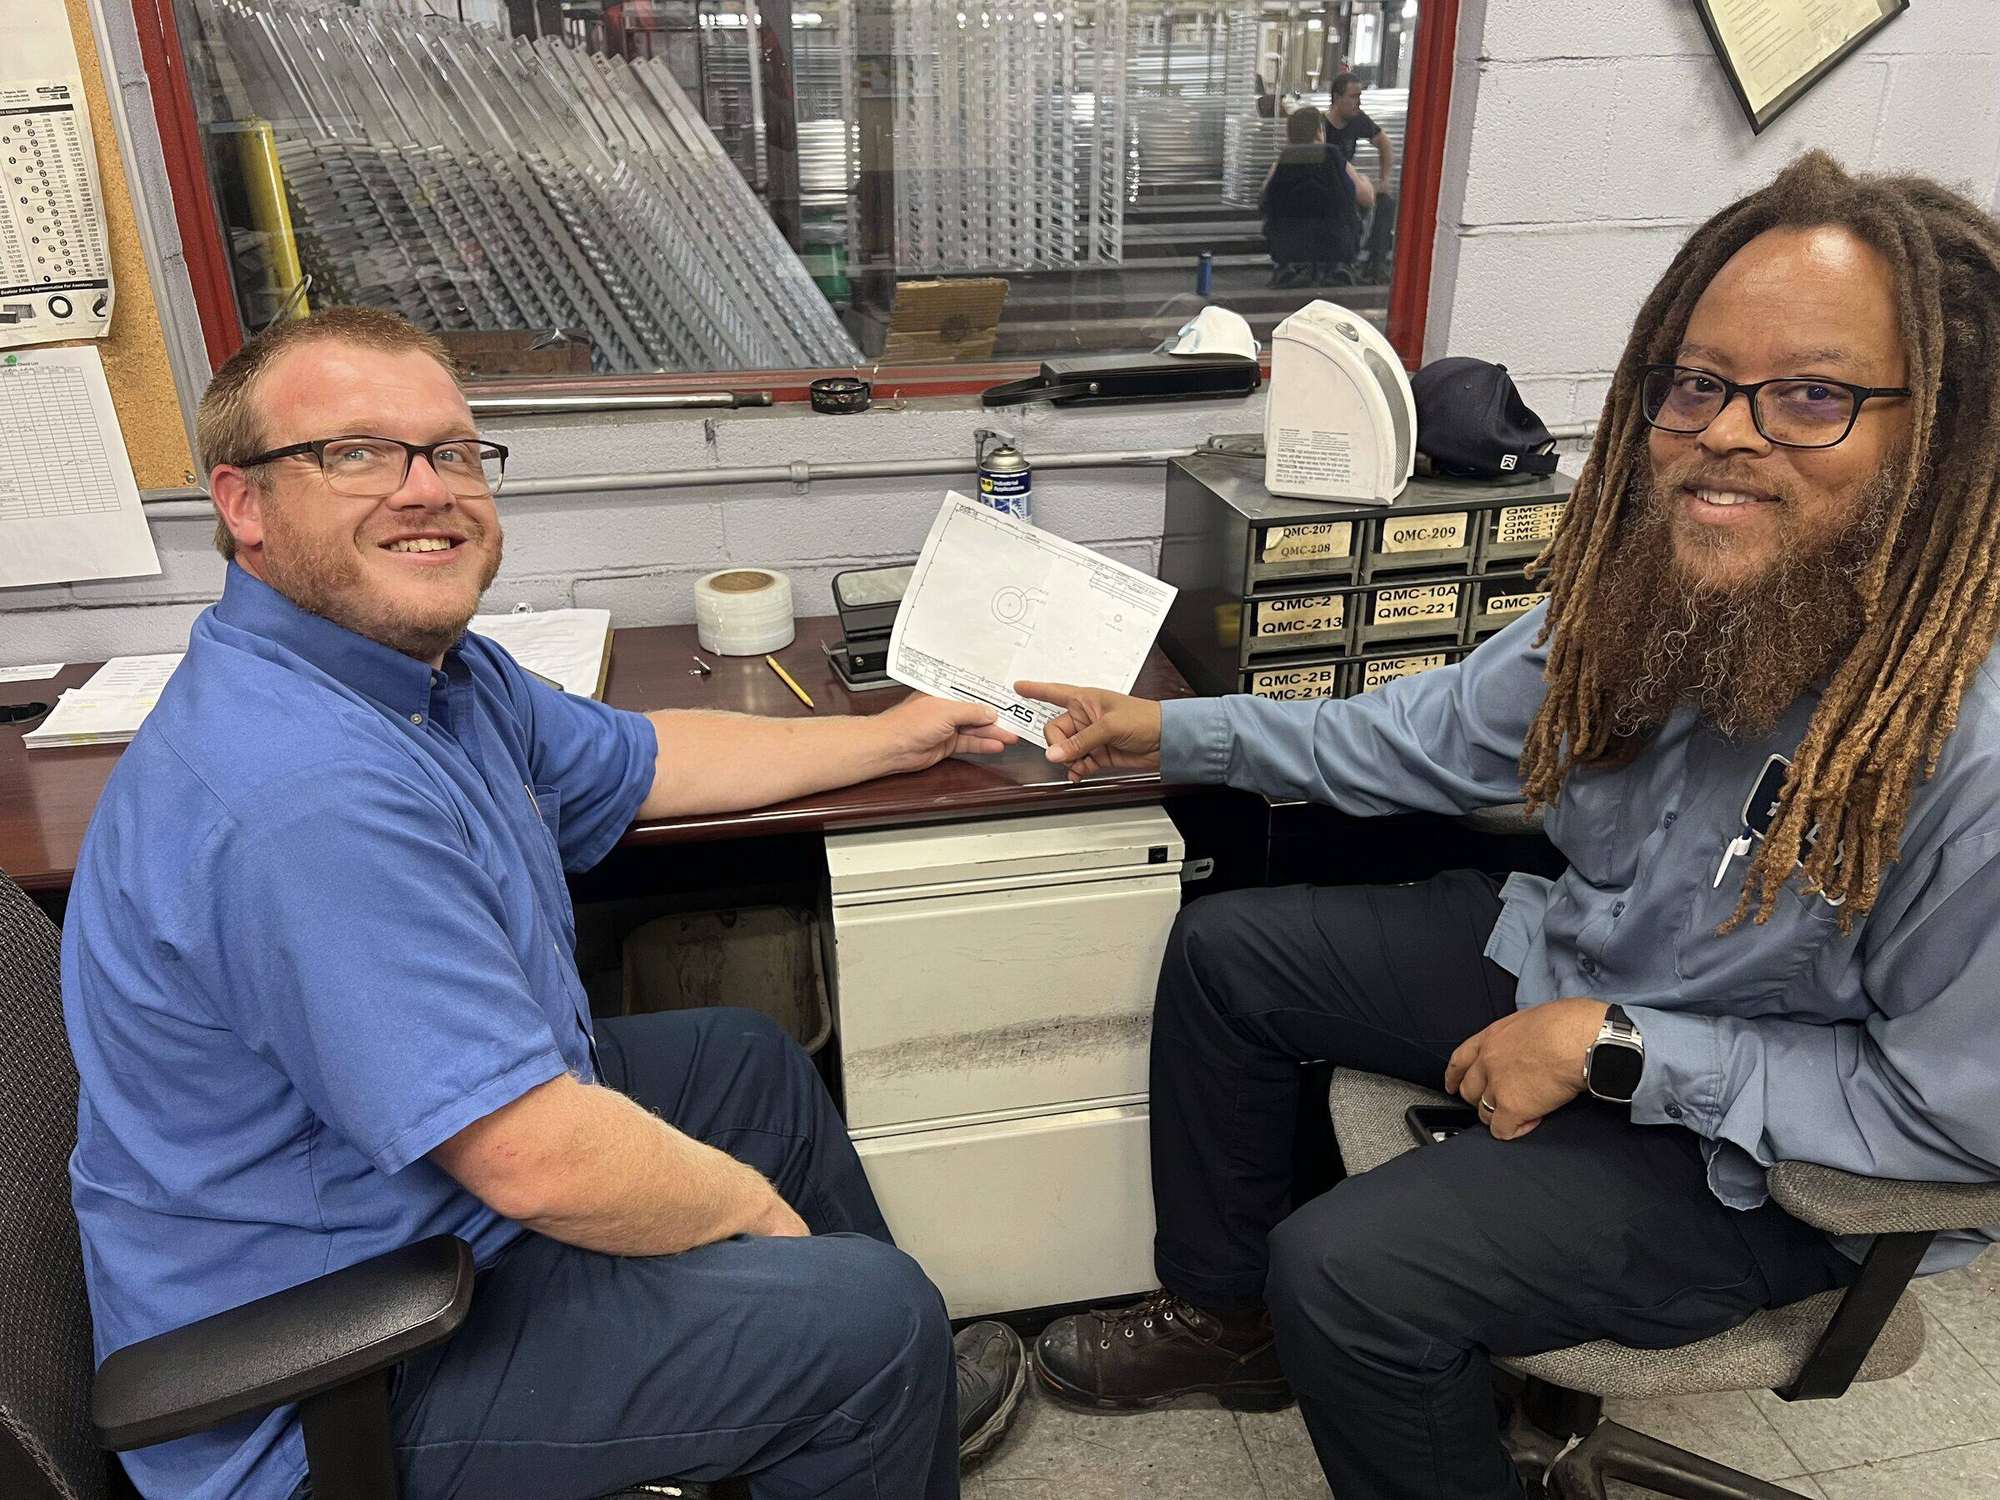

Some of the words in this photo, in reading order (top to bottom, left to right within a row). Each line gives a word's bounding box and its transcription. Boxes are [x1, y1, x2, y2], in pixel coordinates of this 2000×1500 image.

[1283, 524, 1333, 539] QMC-207
[1393, 526, 1457, 544] QMC-209
[1281, 543, 1331, 557] QMC-208
[1379, 586, 1459, 601] QMC-10A
[1271, 596, 1331, 611] QMC-2
[1491, 594, 1551, 610] QMC-2
[1378, 602, 1454, 619] QMC-221
[1262, 617, 1342, 634] QMC-213
[1259, 671, 1331, 687] QMC-2B
